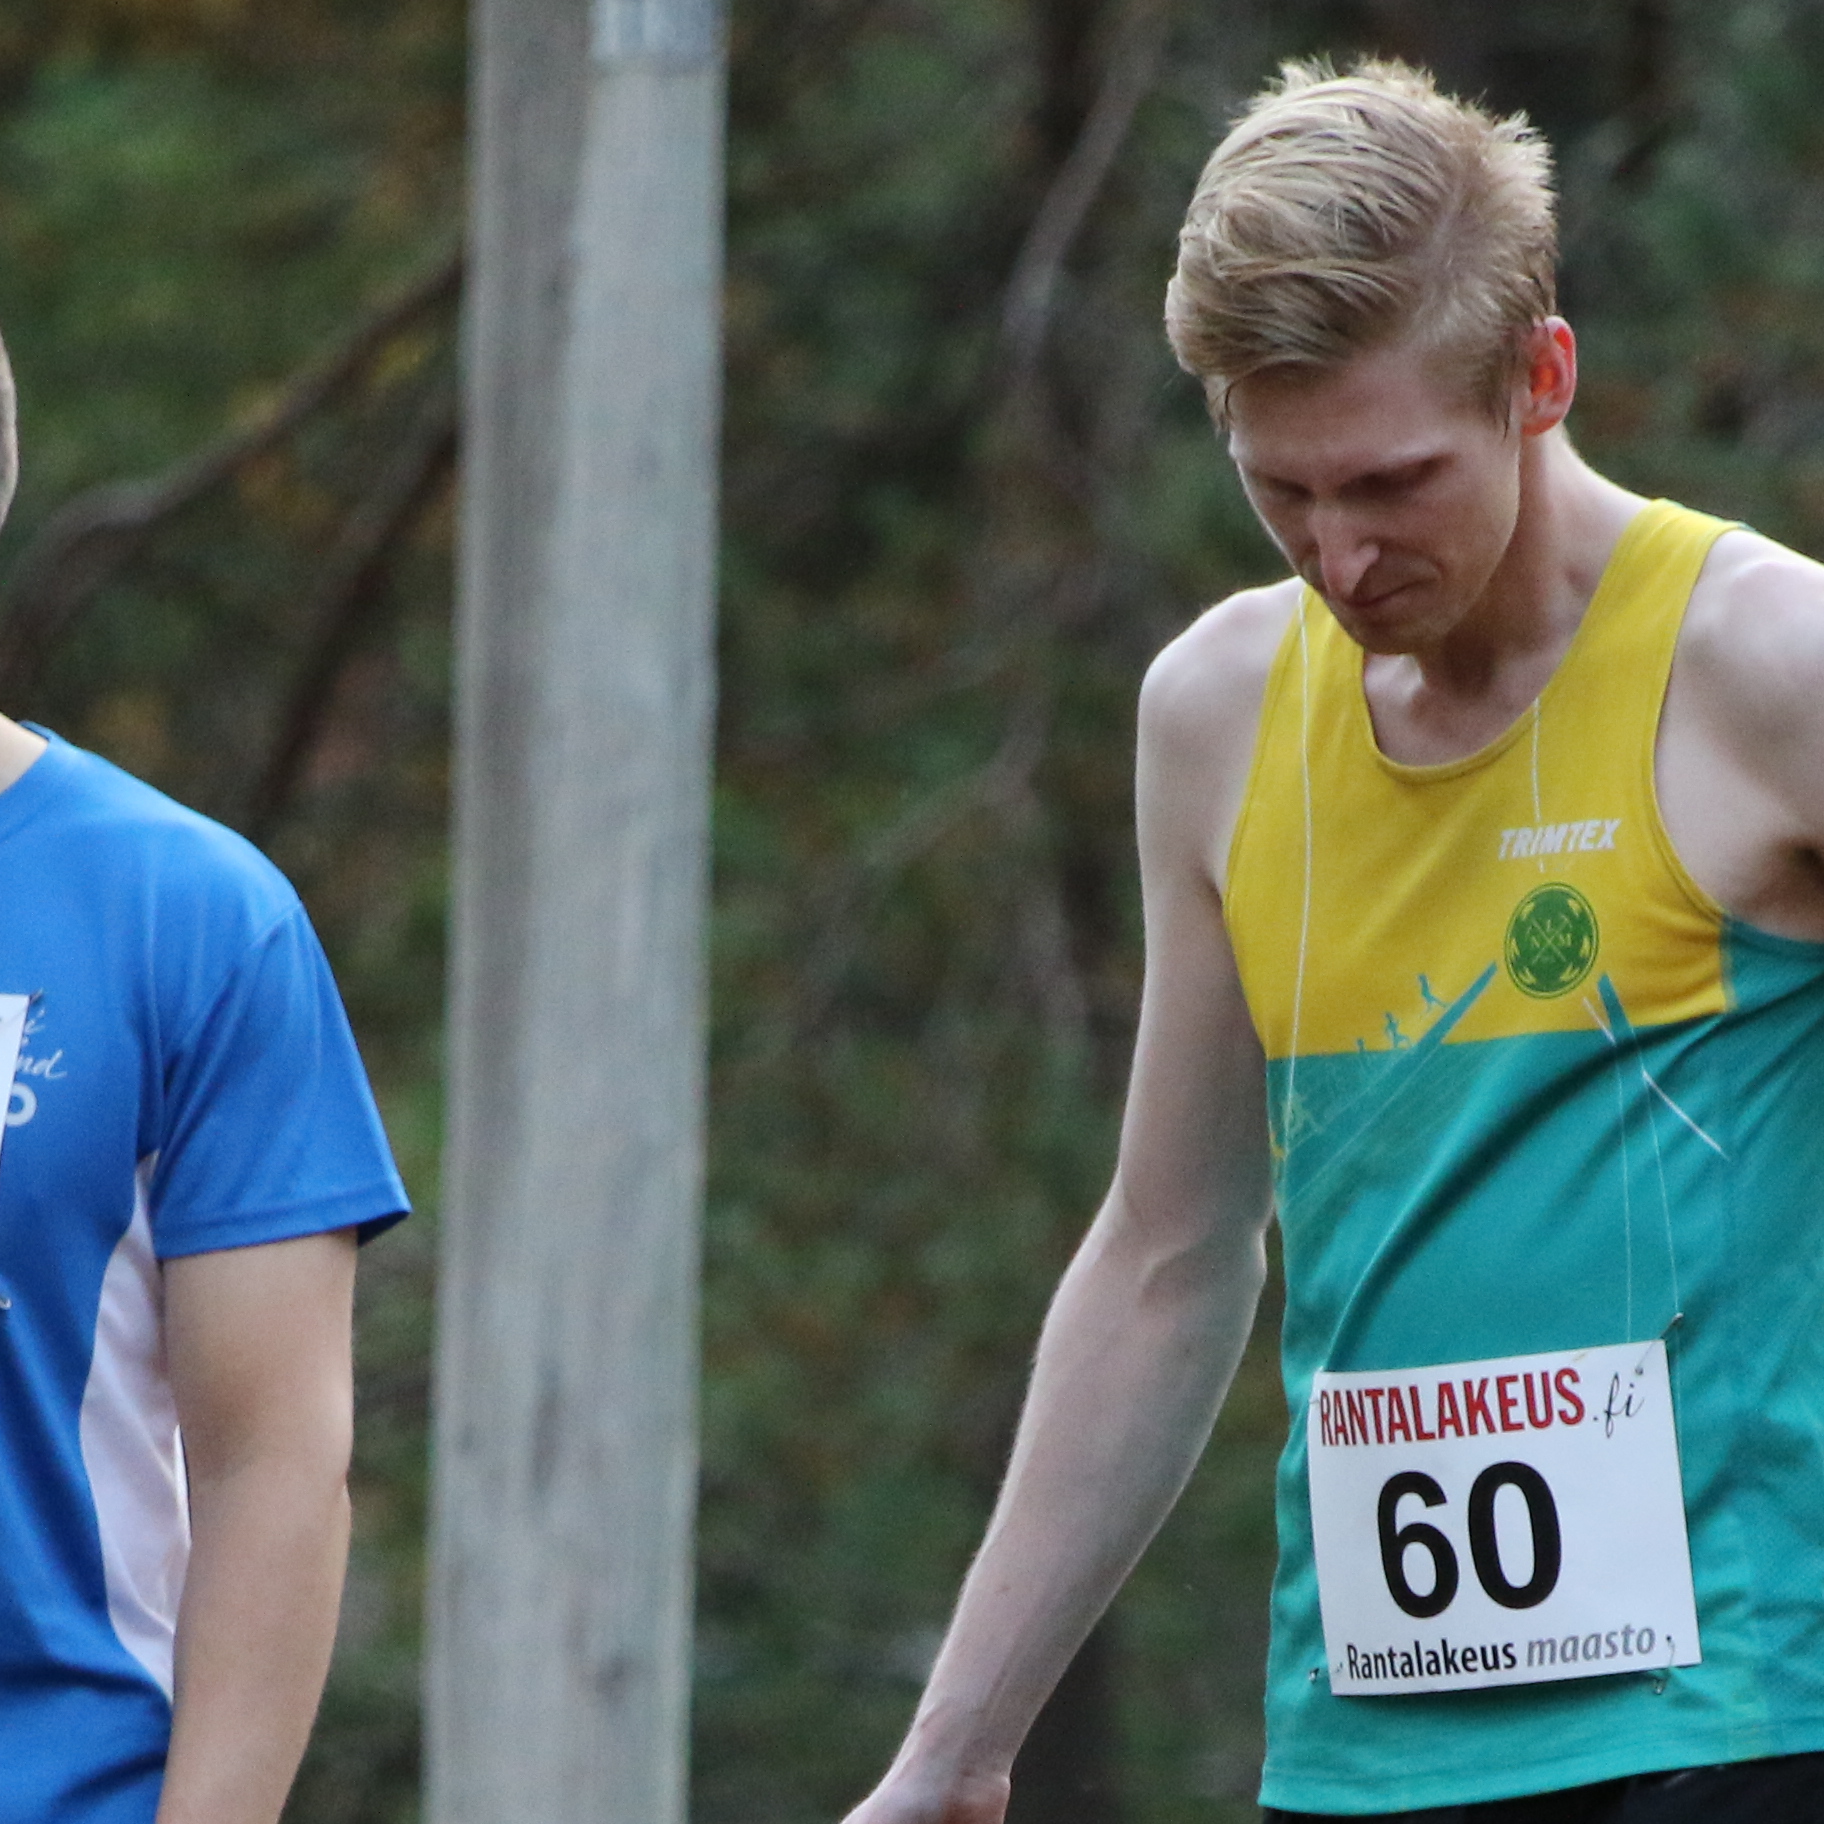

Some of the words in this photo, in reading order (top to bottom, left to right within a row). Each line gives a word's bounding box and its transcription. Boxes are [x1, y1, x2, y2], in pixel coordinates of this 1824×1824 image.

[1498, 818, 1622, 861] TRIMTEX
[1320, 1367, 1586, 1447] RANTALAKEUS
[1378, 1461, 1562, 1619] 60
[1347, 1638, 1517, 1681] Rantalakeus
[1526, 1623, 1656, 1668] maasto
